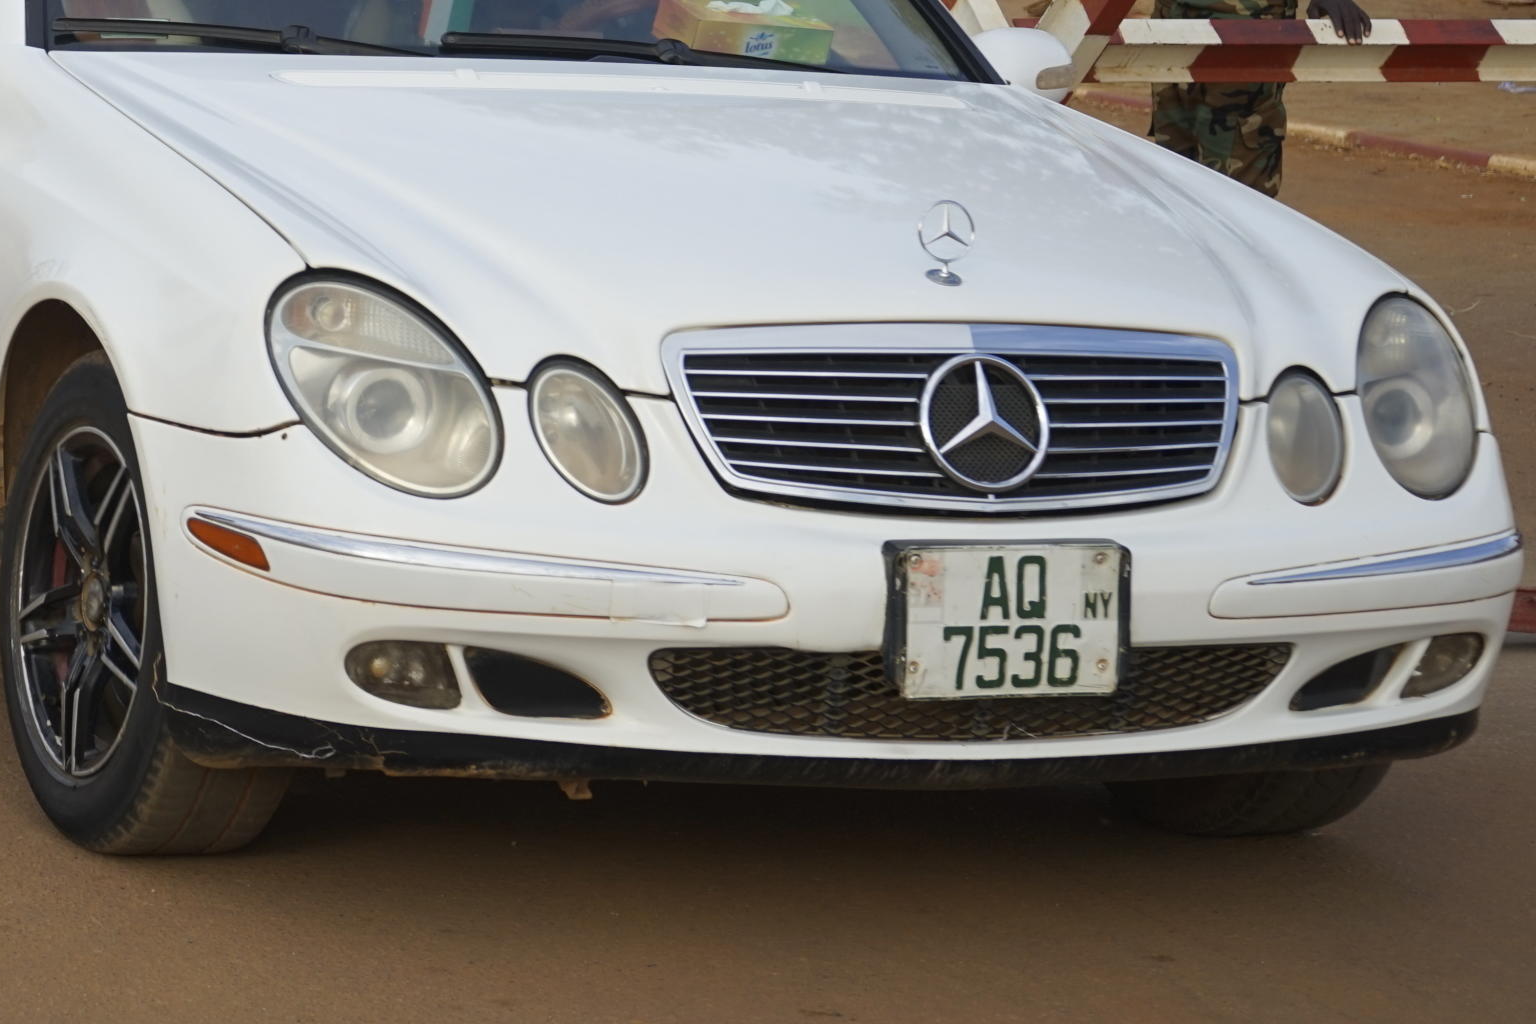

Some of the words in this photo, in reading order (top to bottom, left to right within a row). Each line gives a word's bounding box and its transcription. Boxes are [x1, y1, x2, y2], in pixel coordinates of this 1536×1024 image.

[744, 42, 773, 54] lotus
[980, 555, 1046, 620] AQ
[1083, 591, 1113, 619] NY
[943, 624, 1081, 690] 7536
